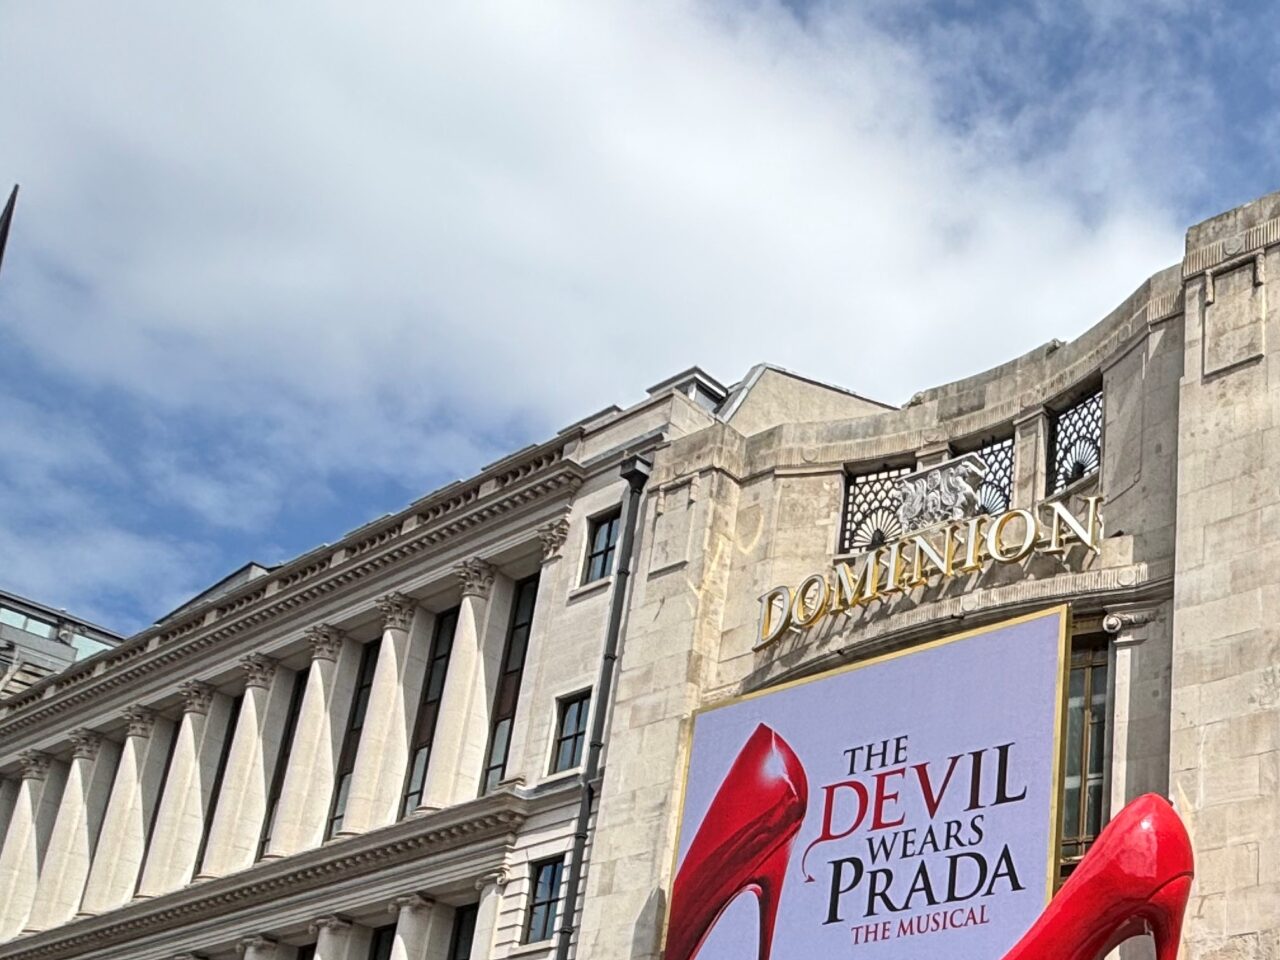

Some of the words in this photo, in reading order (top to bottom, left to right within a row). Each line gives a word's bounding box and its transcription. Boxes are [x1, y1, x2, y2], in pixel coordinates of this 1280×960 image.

[752, 496, 1103, 651] DOMINION
[844, 735, 909, 776] THE
[820, 742, 1028, 842] DEVIL
[866, 815, 985, 862] WEARS
[822, 843, 1025, 925] PRADA
[851, 922, 891, 945] THE
[896, 905, 990, 938] MUSICAL
